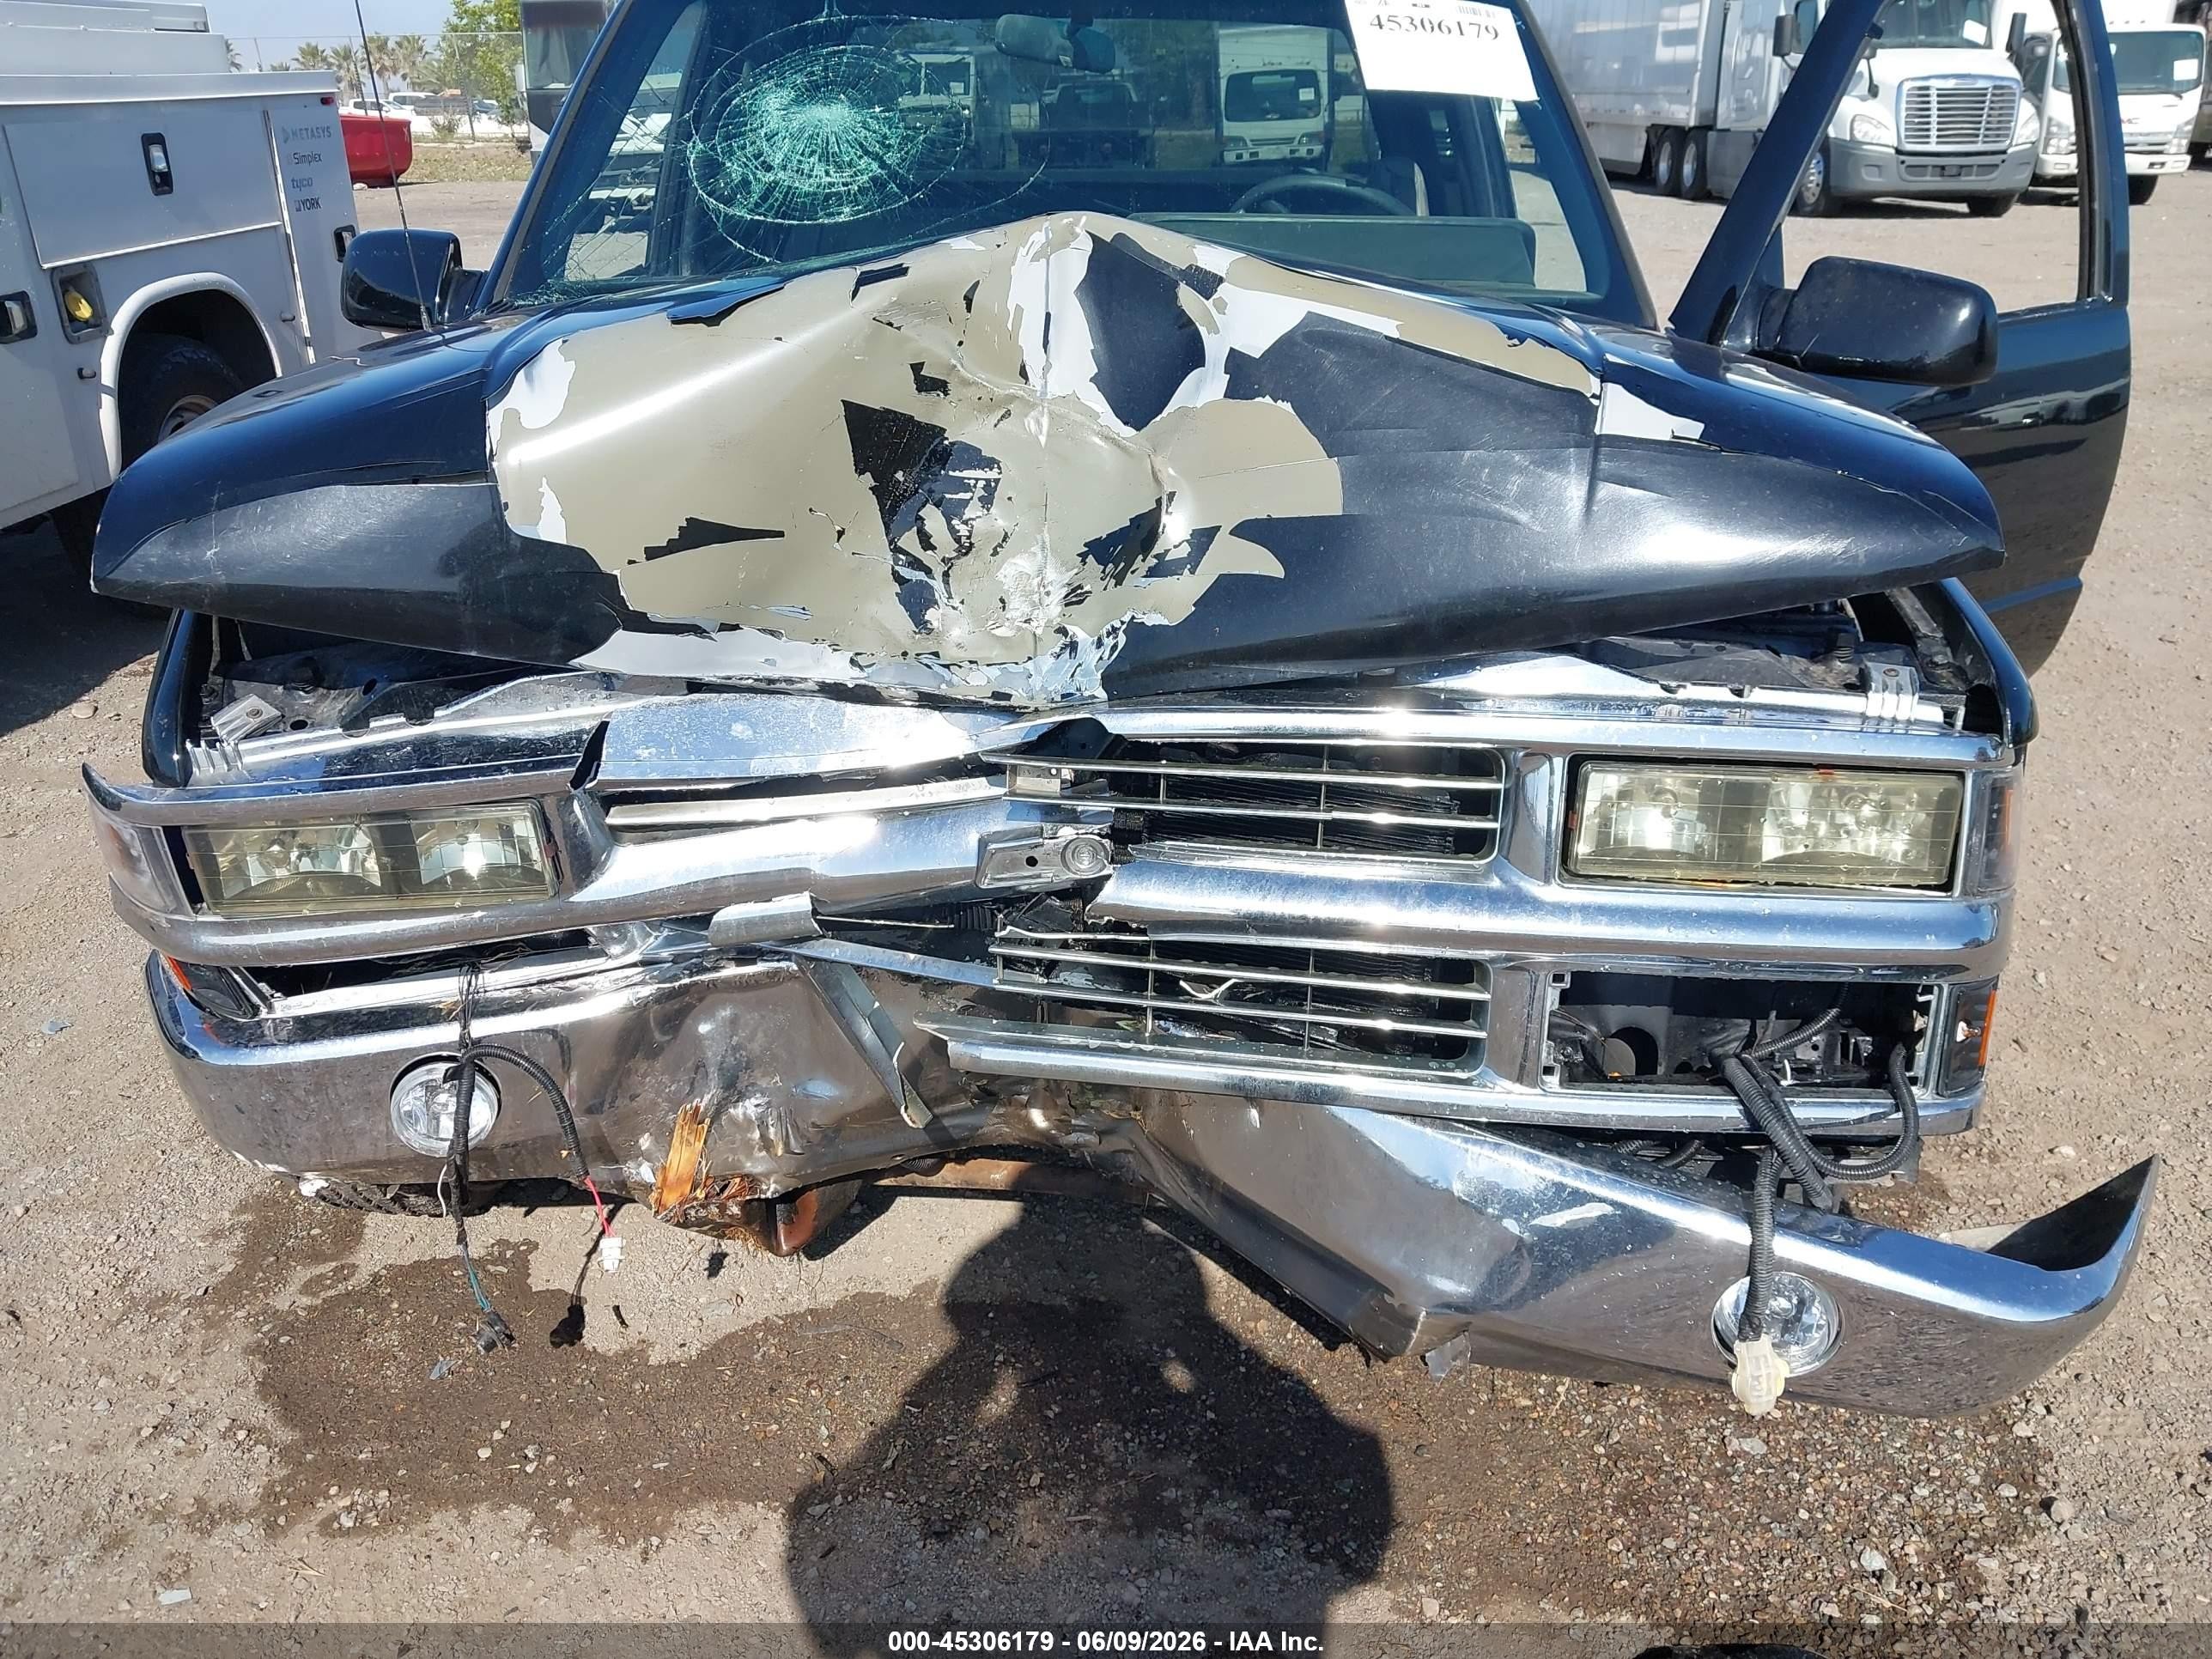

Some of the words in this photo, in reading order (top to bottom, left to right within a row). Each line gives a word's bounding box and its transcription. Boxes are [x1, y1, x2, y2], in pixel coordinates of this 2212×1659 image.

[1370, 14, 1499, 40] 45306179
[290, 126, 331, 140] METASYS
[293, 151, 322, 166] Simplex
[291, 177, 313, 191] tyco
[301, 197, 321, 210] YORK
